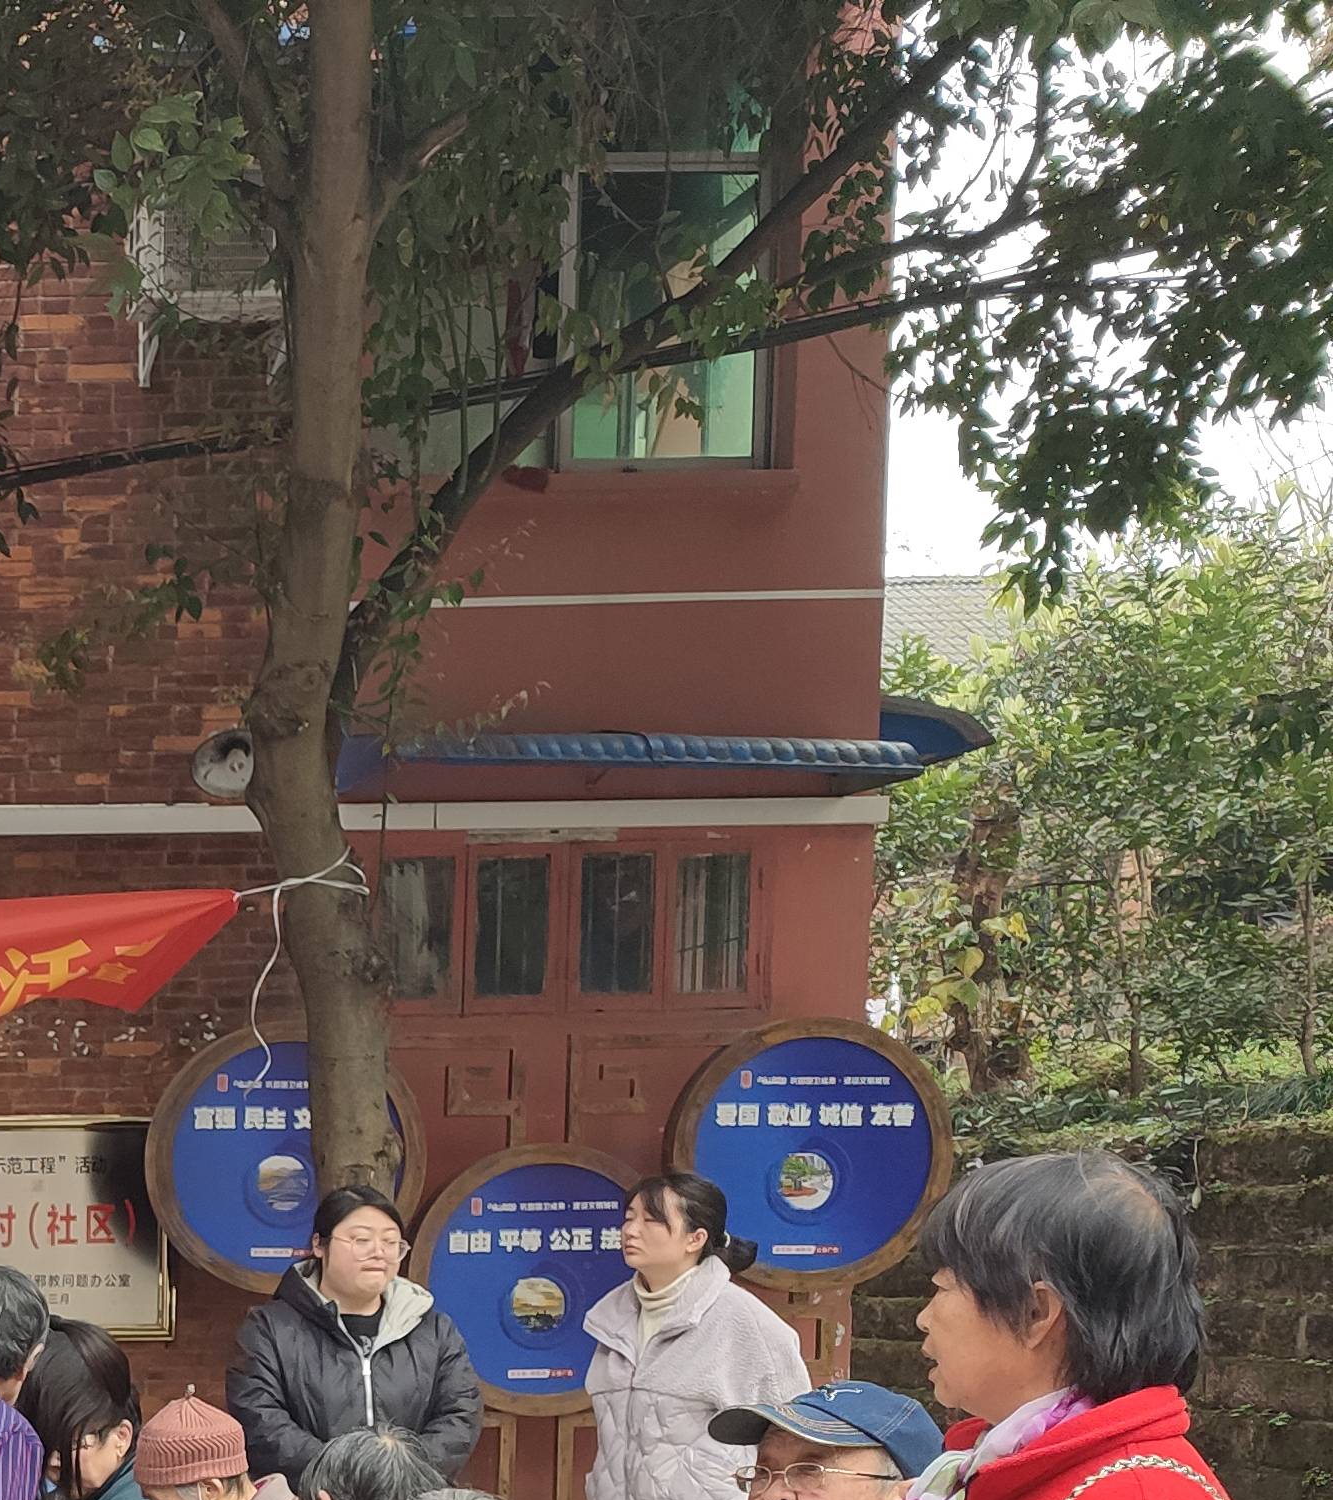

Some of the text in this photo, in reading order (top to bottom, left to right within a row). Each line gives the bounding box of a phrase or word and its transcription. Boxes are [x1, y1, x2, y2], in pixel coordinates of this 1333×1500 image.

[244, 1106, 287, 1130] 民主
[449, 1229, 492, 1254] 自由
[549, 1227, 593, 1252] 公正
